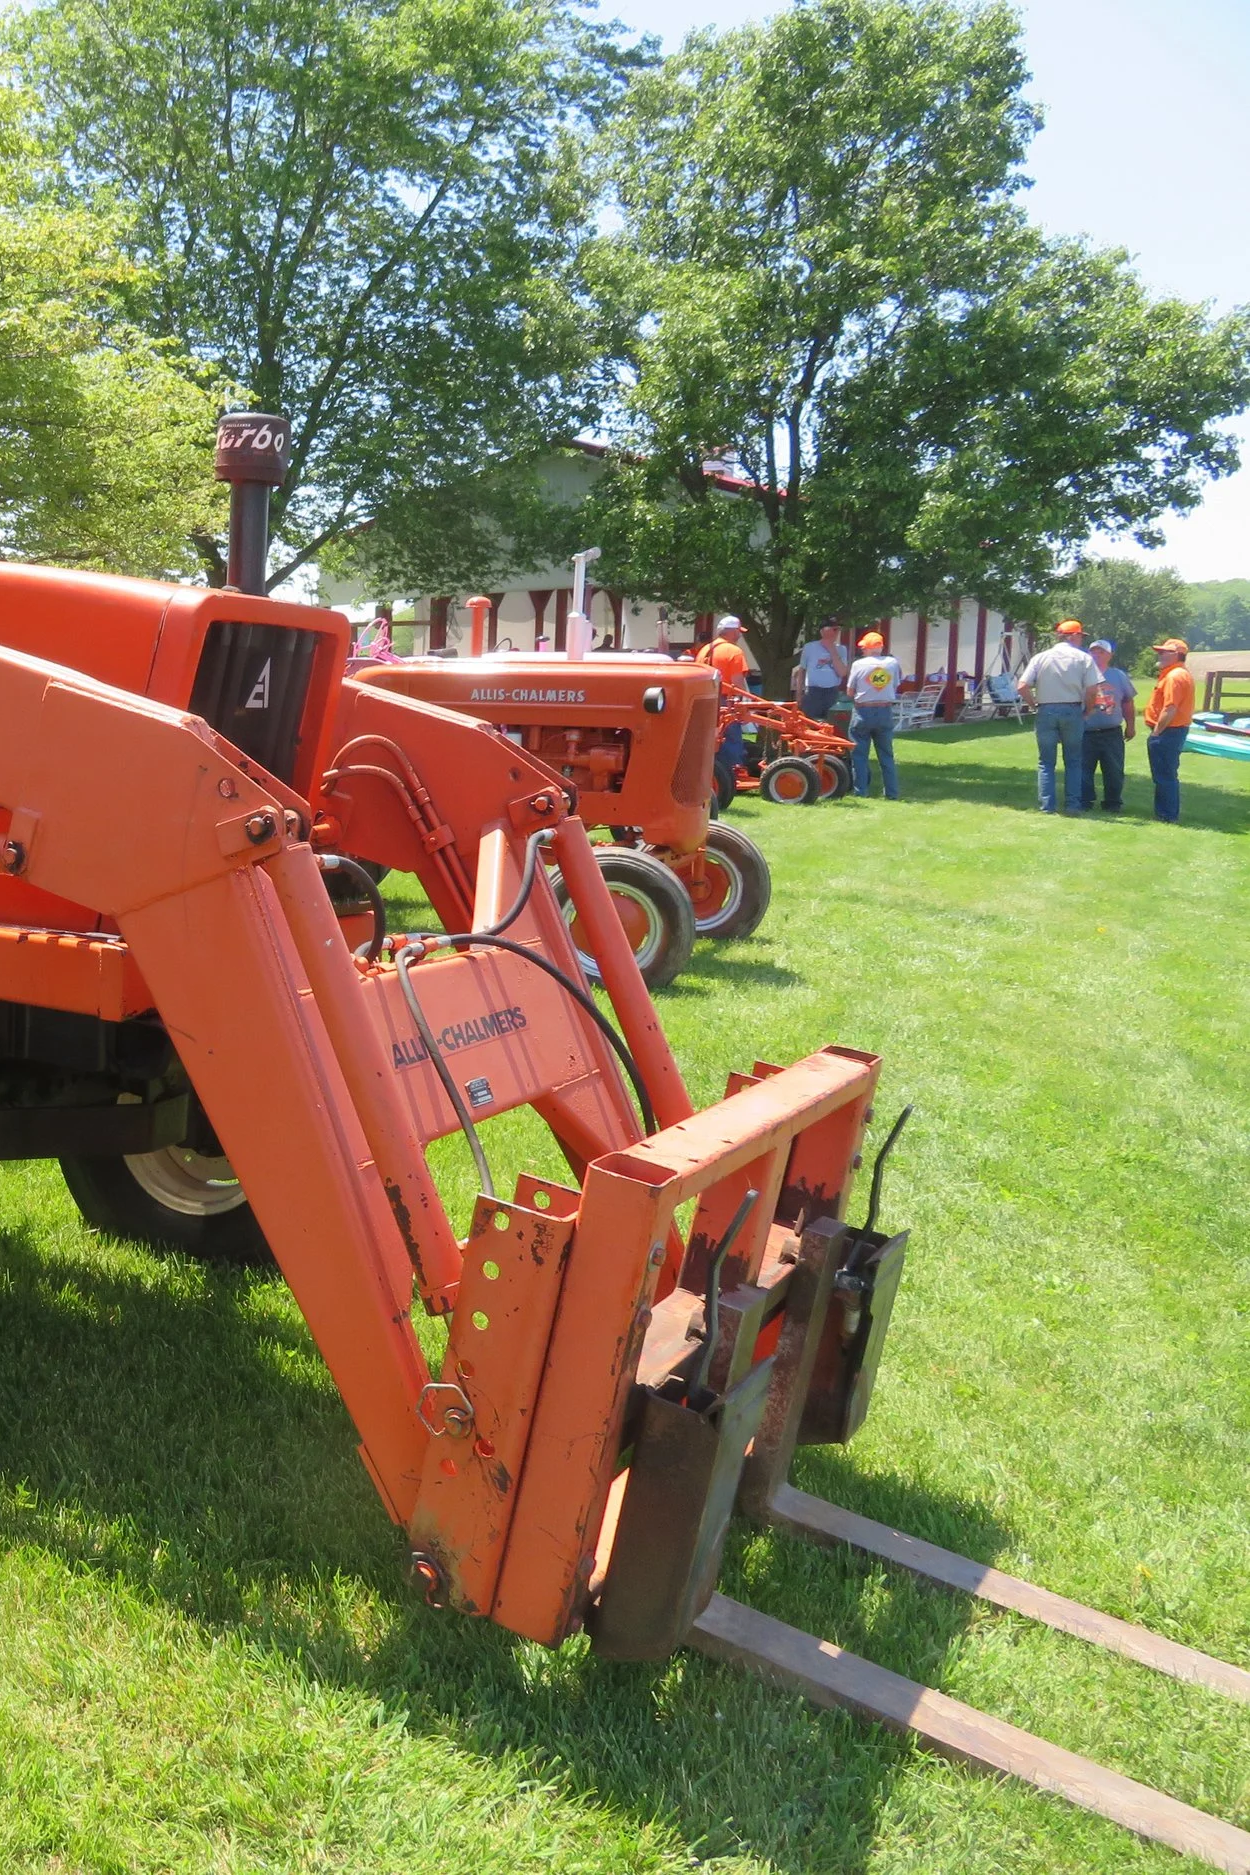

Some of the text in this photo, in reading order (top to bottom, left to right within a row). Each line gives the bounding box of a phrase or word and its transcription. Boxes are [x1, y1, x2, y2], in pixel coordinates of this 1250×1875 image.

[216, 424, 284, 452] turbo
[470, 688, 586, 702] ALLIS-CHALMERS
[392, 1007, 527, 1069] ALLI-CHALMERS
